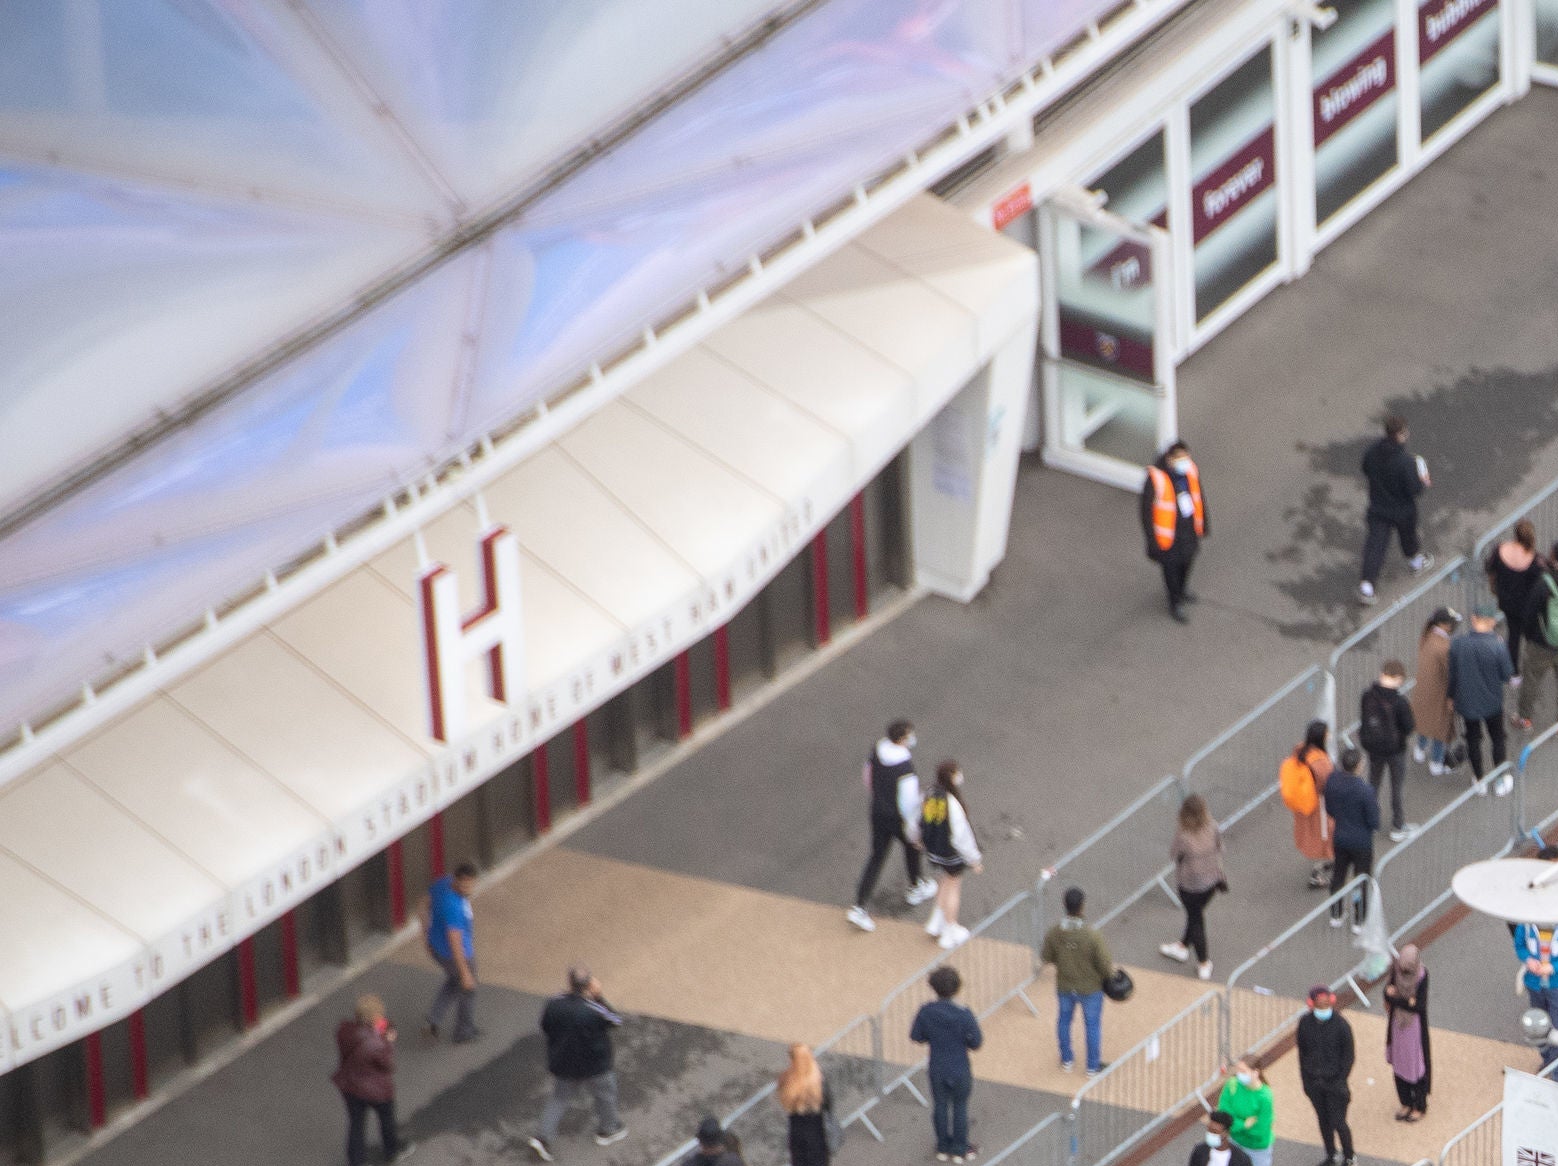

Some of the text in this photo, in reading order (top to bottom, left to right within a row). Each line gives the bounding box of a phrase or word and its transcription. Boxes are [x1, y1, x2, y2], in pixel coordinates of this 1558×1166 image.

[1202, 156, 1264, 219] forever
[1320, 55, 1387, 122] blowing
[417, 525, 524, 747] H
[181, 909, 227, 960] THE
[245, 833, 347, 919] LONDON
[363, 748, 477, 839] STADIUM
[492, 695, 558, 751] HOME
[609, 611, 673, 678] WEST
